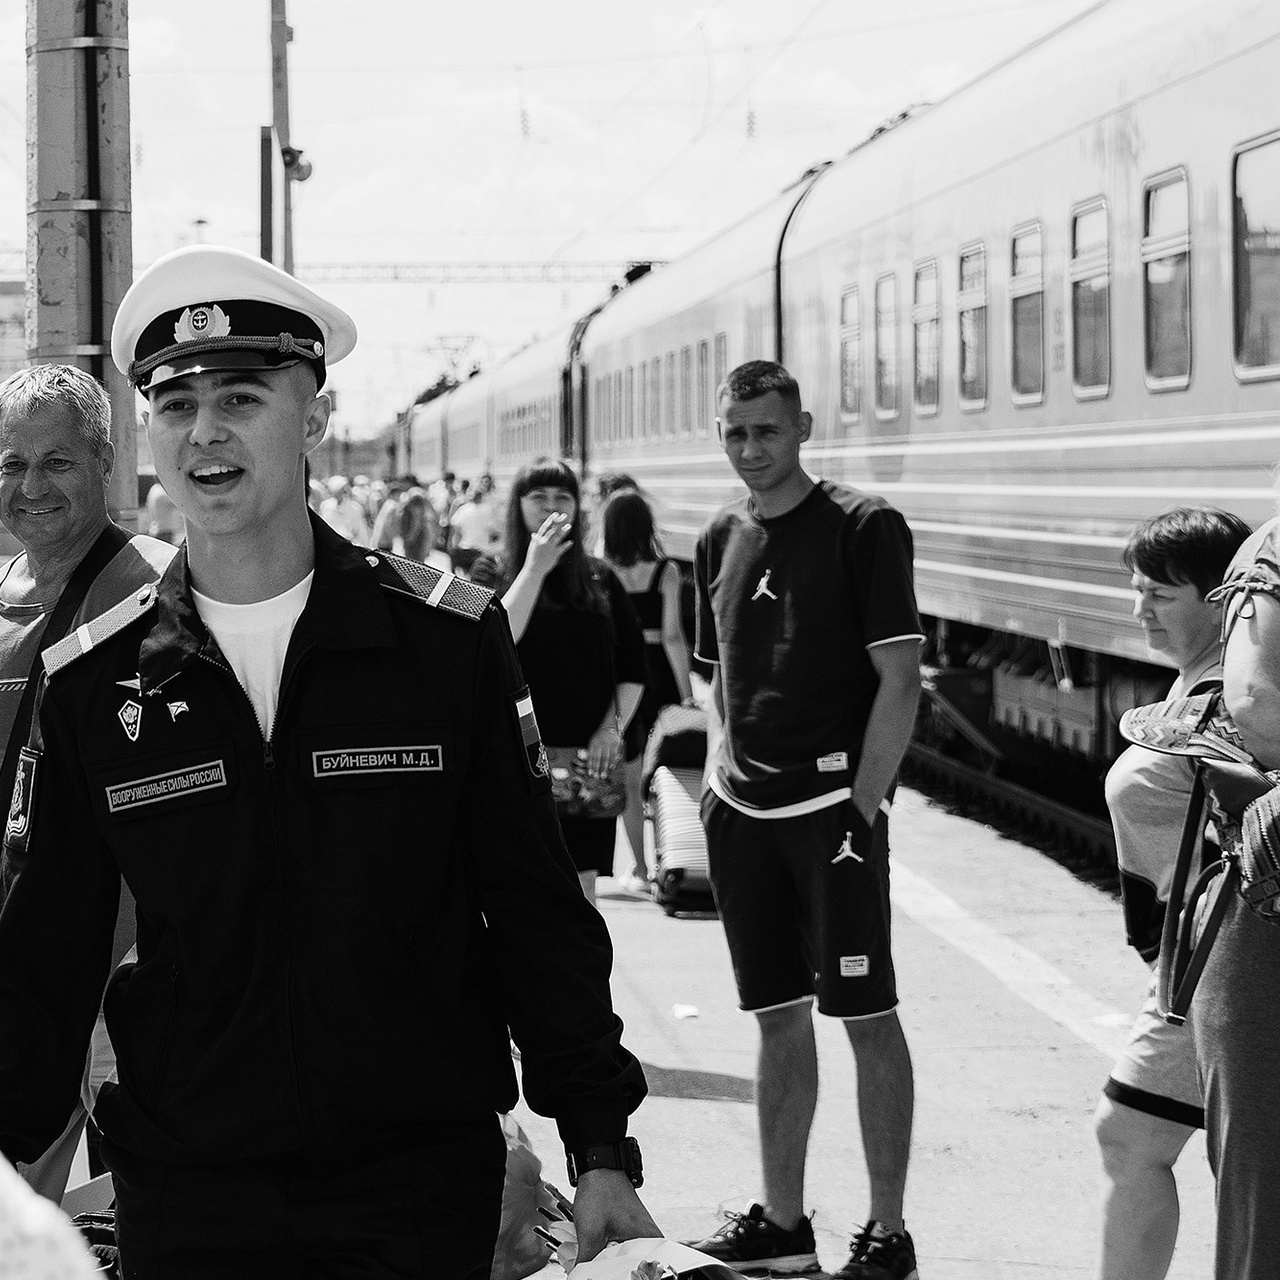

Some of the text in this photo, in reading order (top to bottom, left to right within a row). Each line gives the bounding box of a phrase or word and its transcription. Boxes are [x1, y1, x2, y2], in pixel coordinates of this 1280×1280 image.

[322, 752, 434, 769] БУЙНЕВИЧ М.Д.
[111, 767, 222, 805] ВООРУЖЕННЫЕ СИЛЫ РОССИИ
